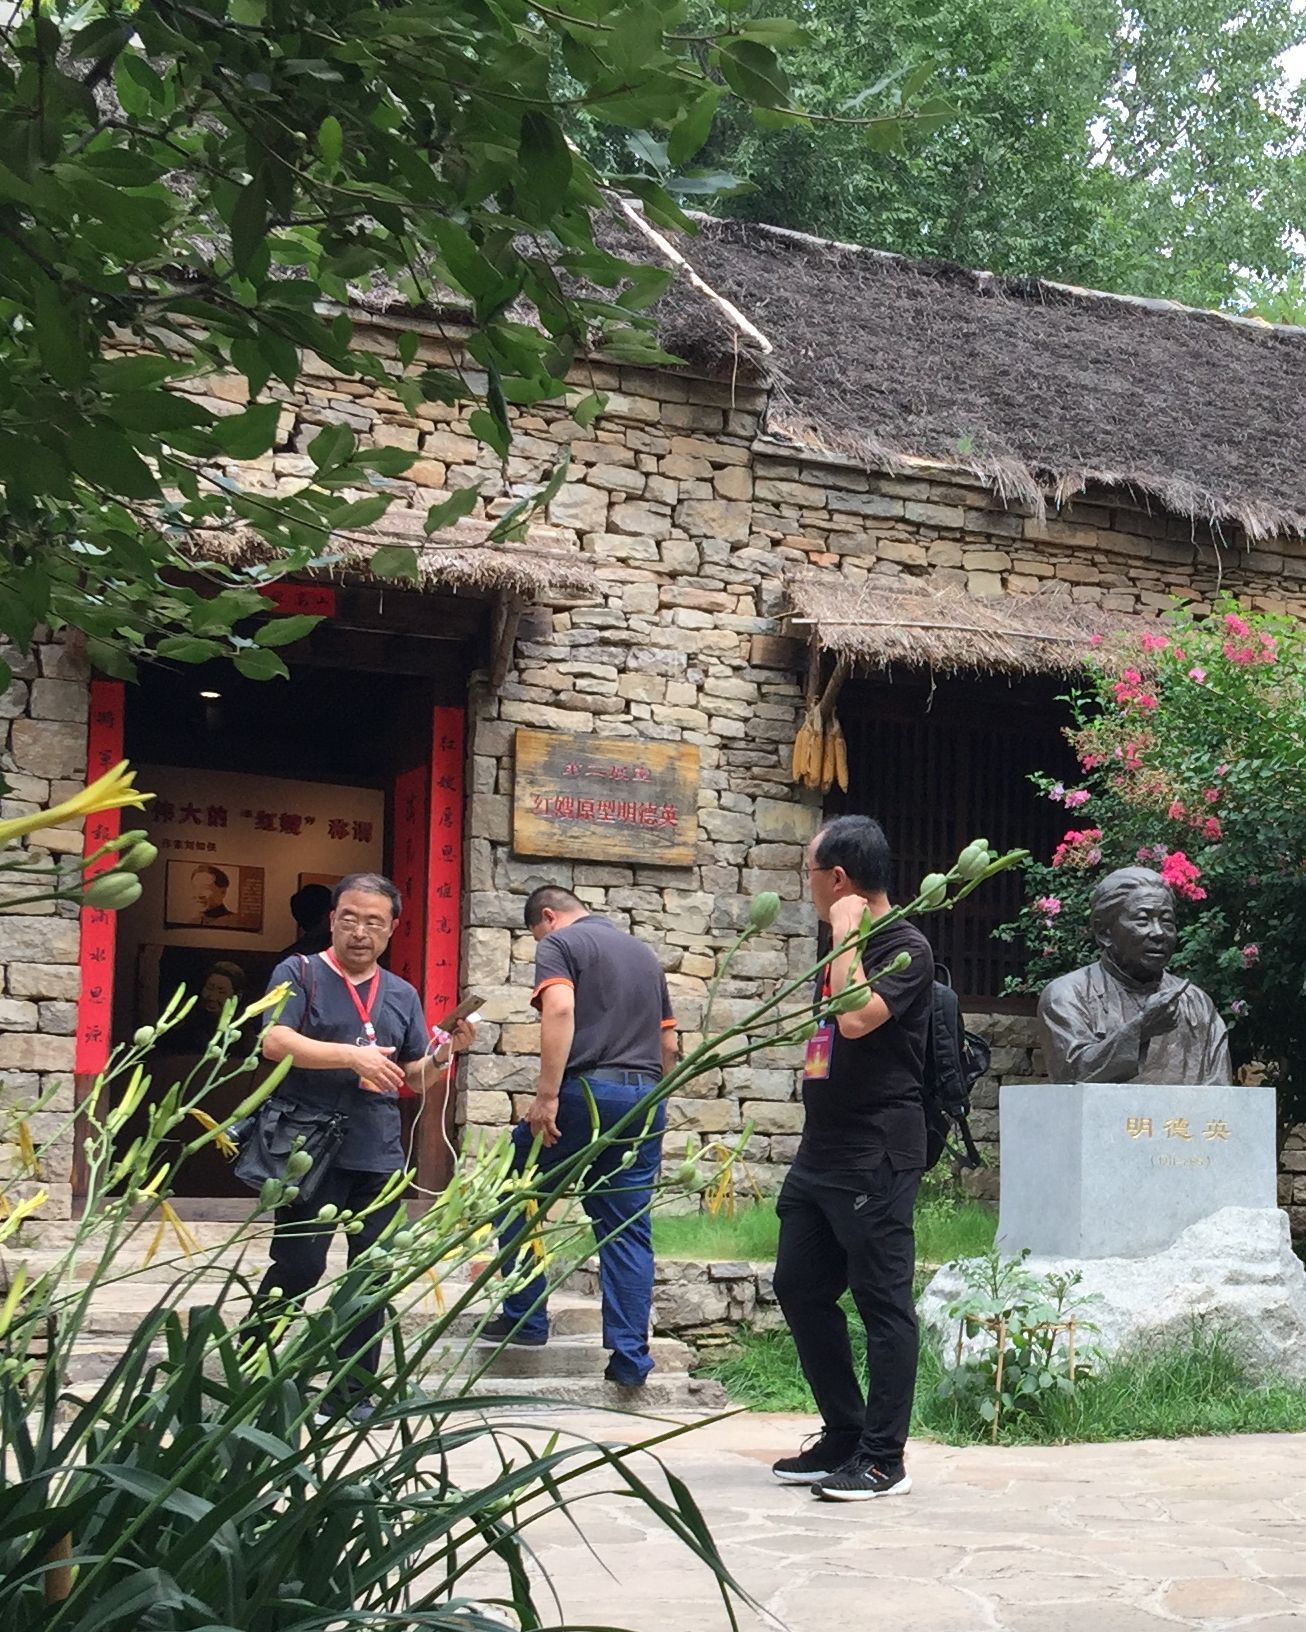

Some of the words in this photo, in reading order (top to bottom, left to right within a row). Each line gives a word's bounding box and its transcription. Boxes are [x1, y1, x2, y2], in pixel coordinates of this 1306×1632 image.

[532, 794, 679, 828] 红嫂原型明德英
[1126, 1116, 1232, 1141] 明德英
